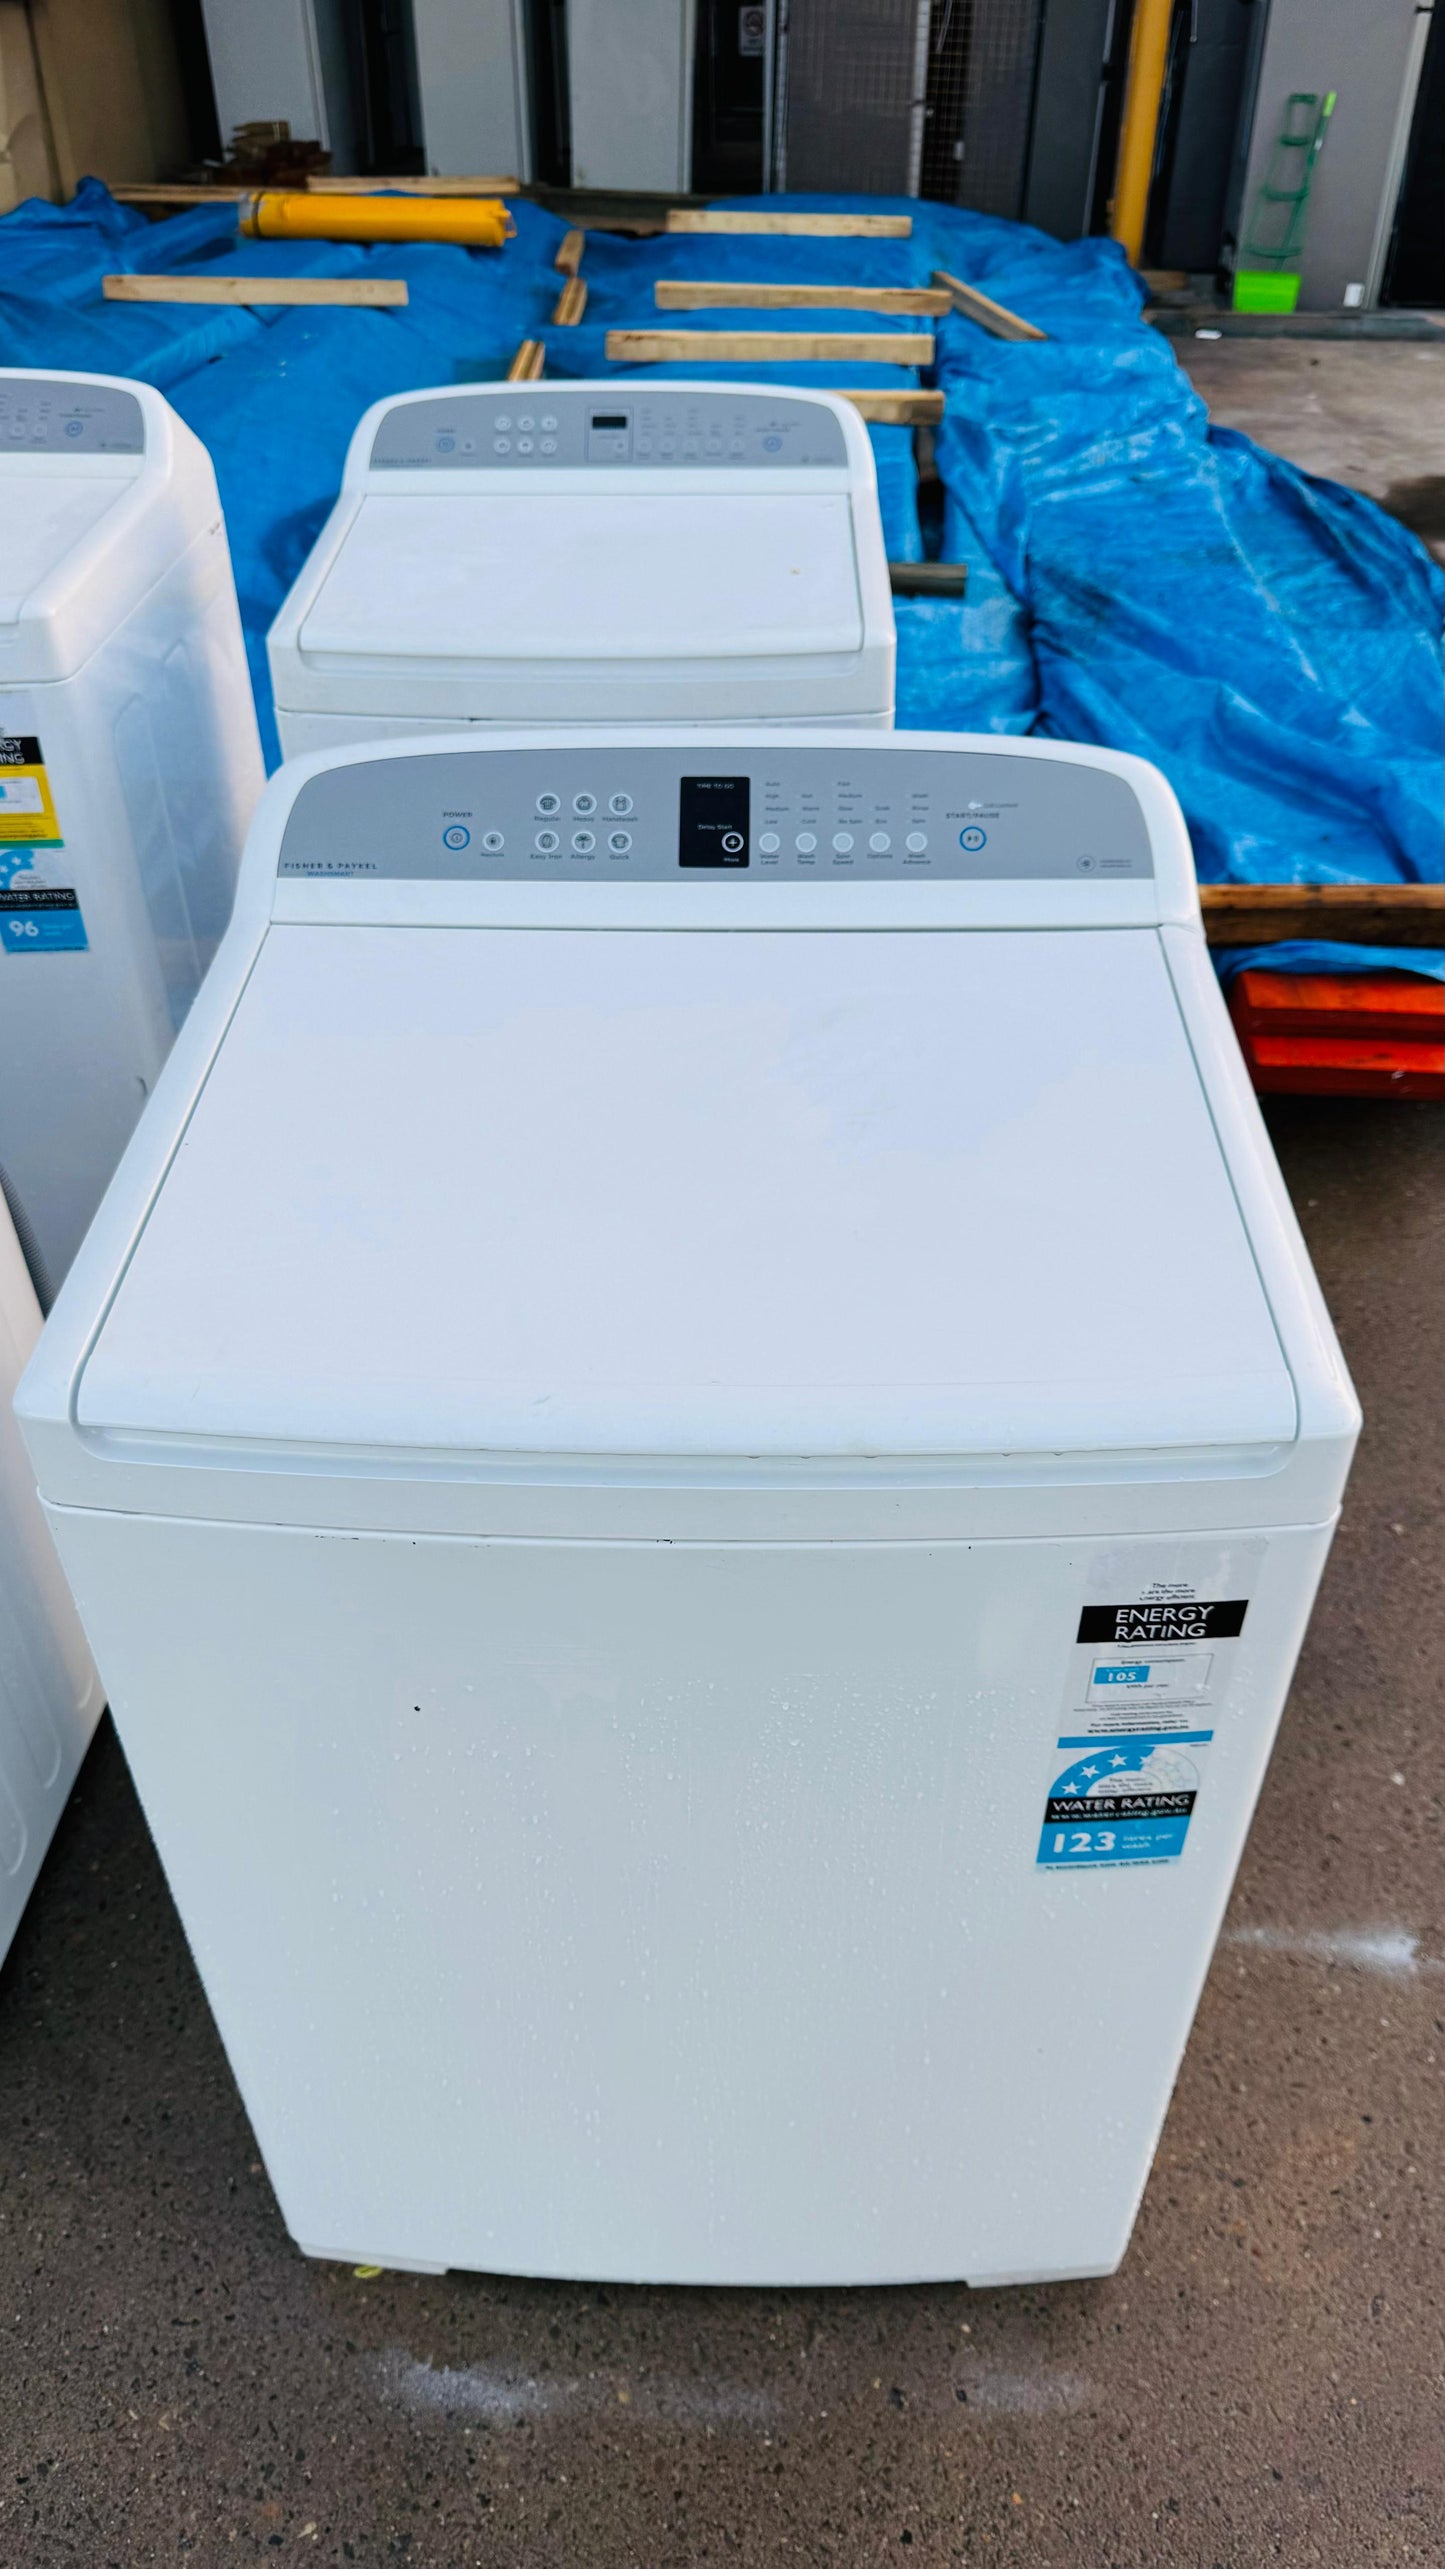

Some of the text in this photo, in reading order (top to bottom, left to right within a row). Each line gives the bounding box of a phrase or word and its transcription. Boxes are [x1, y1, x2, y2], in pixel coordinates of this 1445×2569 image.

[9, 920, 39, 937] 96
[1115, 1605, 1215, 1623] ENERGY
[1114, 1622, 1208, 1640] RATING
[1108, 1672, 1137, 1682] 105
[1052, 1794, 1191, 1812] WATER RATING
[1053, 1831, 1117, 1853] 123
